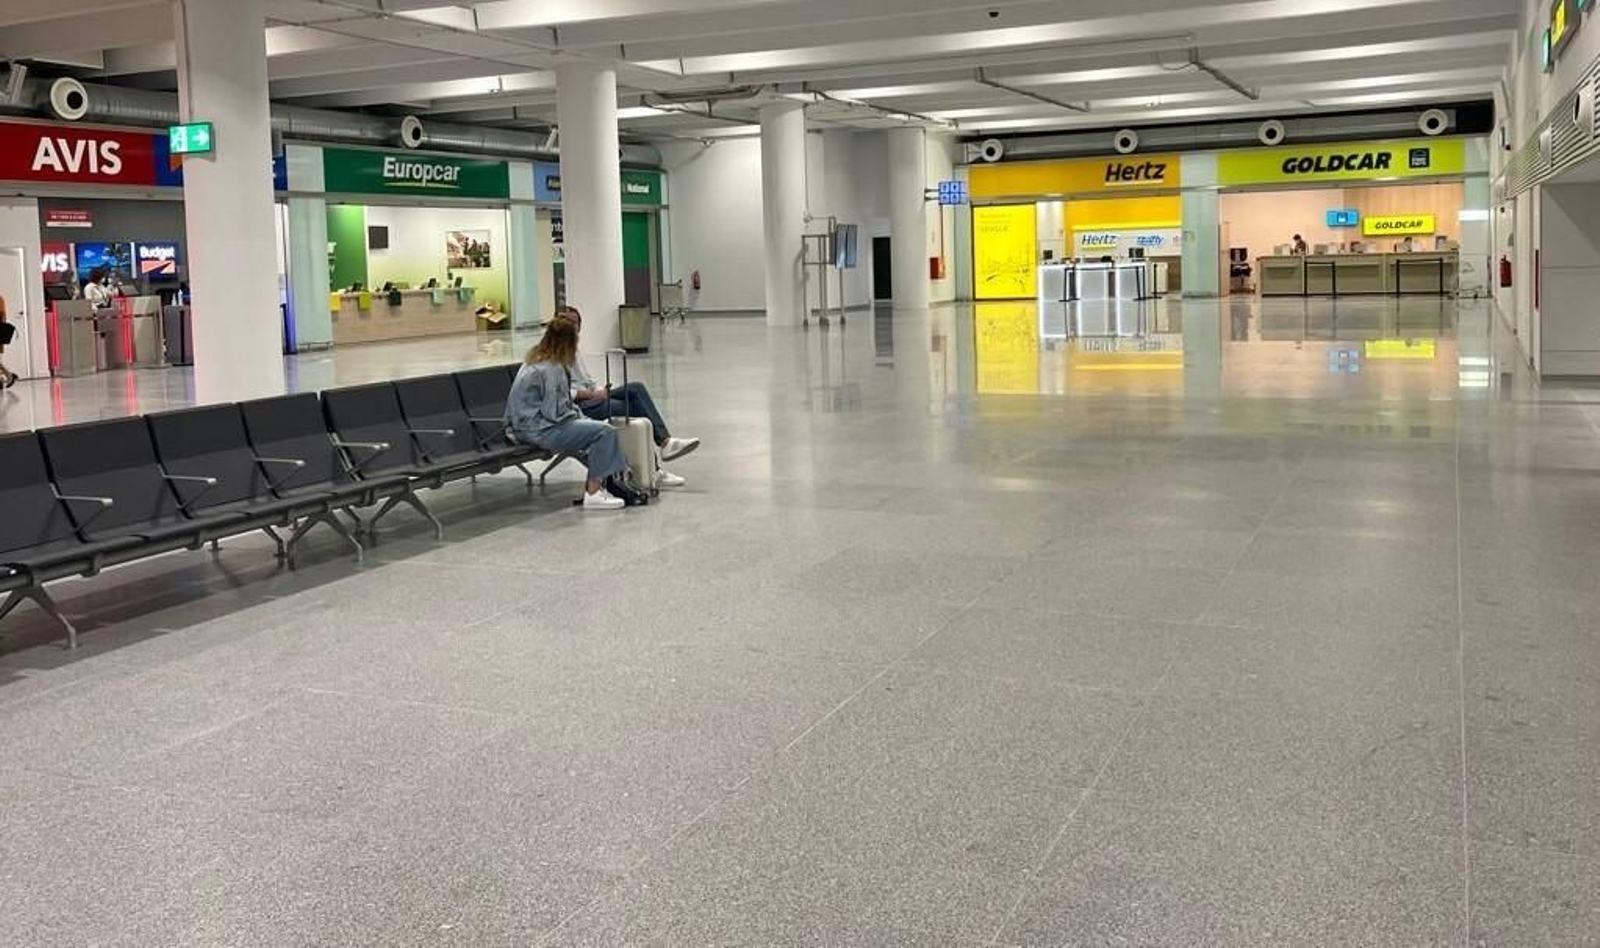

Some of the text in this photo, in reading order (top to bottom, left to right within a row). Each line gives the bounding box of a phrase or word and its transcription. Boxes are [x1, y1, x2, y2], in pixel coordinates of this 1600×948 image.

[32, 137, 122, 175] AVIS
[1282, 152, 1392, 174] GOLDCAR
[383, 157, 462, 186] Europcar
[1106, 162, 1166, 181] Hertz
[1374, 220, 1424, 230] GOLDCAR
[1082, 233, 1118, 246] Hertz
[40, 253, 68, 272] VIS
[139, 246, 175, 261] Budget
